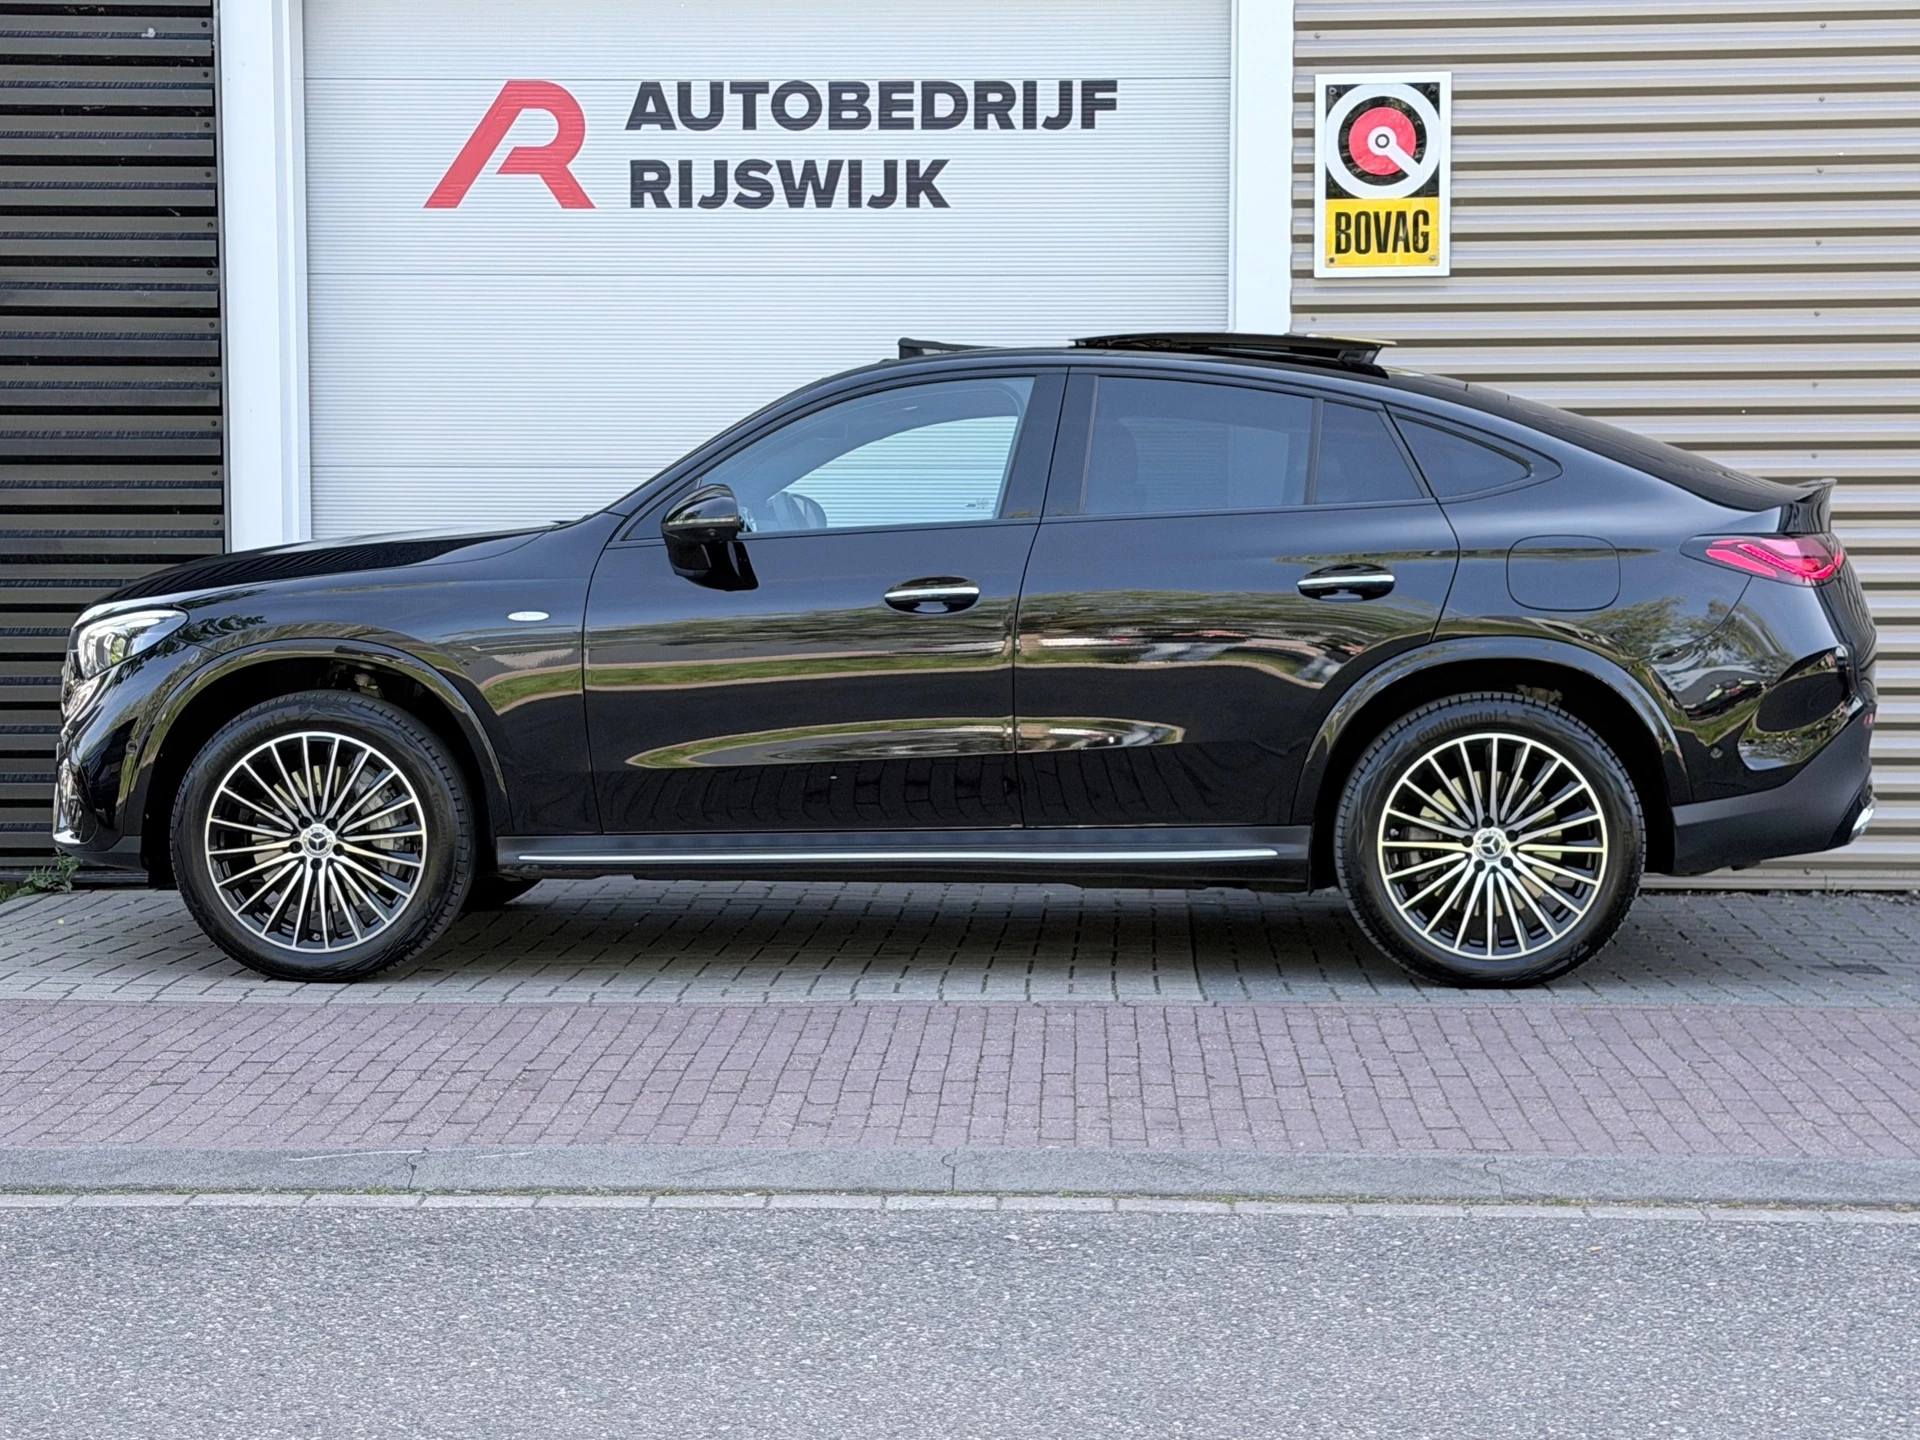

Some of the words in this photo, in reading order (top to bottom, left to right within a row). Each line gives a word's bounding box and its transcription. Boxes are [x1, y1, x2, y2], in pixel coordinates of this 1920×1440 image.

[626, 80, 1118, 131] AUTOBEDRIJF
[630, 159, 950, 210] RIJSWIJK
[1335, 210, 1430, 255] BOVAG
[1416, 709, 1498, 743] Continental
